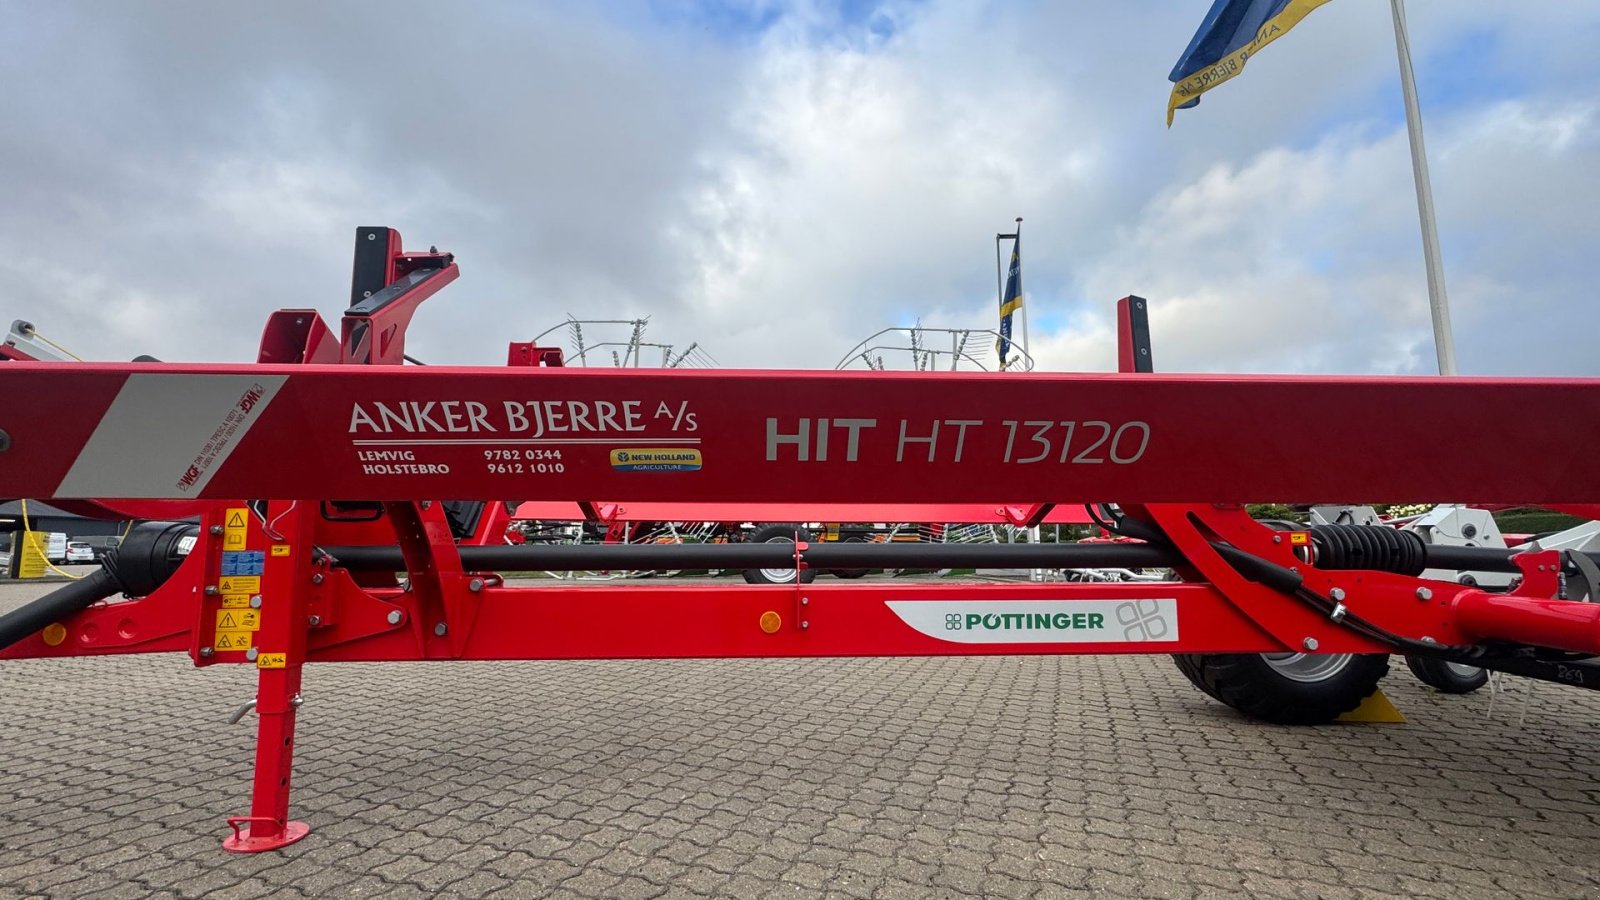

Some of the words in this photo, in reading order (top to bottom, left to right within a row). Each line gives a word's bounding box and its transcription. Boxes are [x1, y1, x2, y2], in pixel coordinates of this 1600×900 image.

[240, 390, 260, 414] WGF
[348, 400, 498, 433] ANKER
[503, 400, 646, 438] BJERRE
[766, 417, 877, 463] HIT
[896, 419, 984, 463] HT
[1002, 420, 1151, 465] 13120
[358, 450, 415, 462] LEMVIG
[484, 450, 521, 461] 9782
[525, 450, 562, 461] 0344
[180, 465, 198, 486] WGF
[363, 463, 450, 475] HOLSTEBRO
[487, 463, 526, 474] 9612
[529, 463, 565, 474] 1010
[965, 612, 1104, 630] PÖTTINGER
